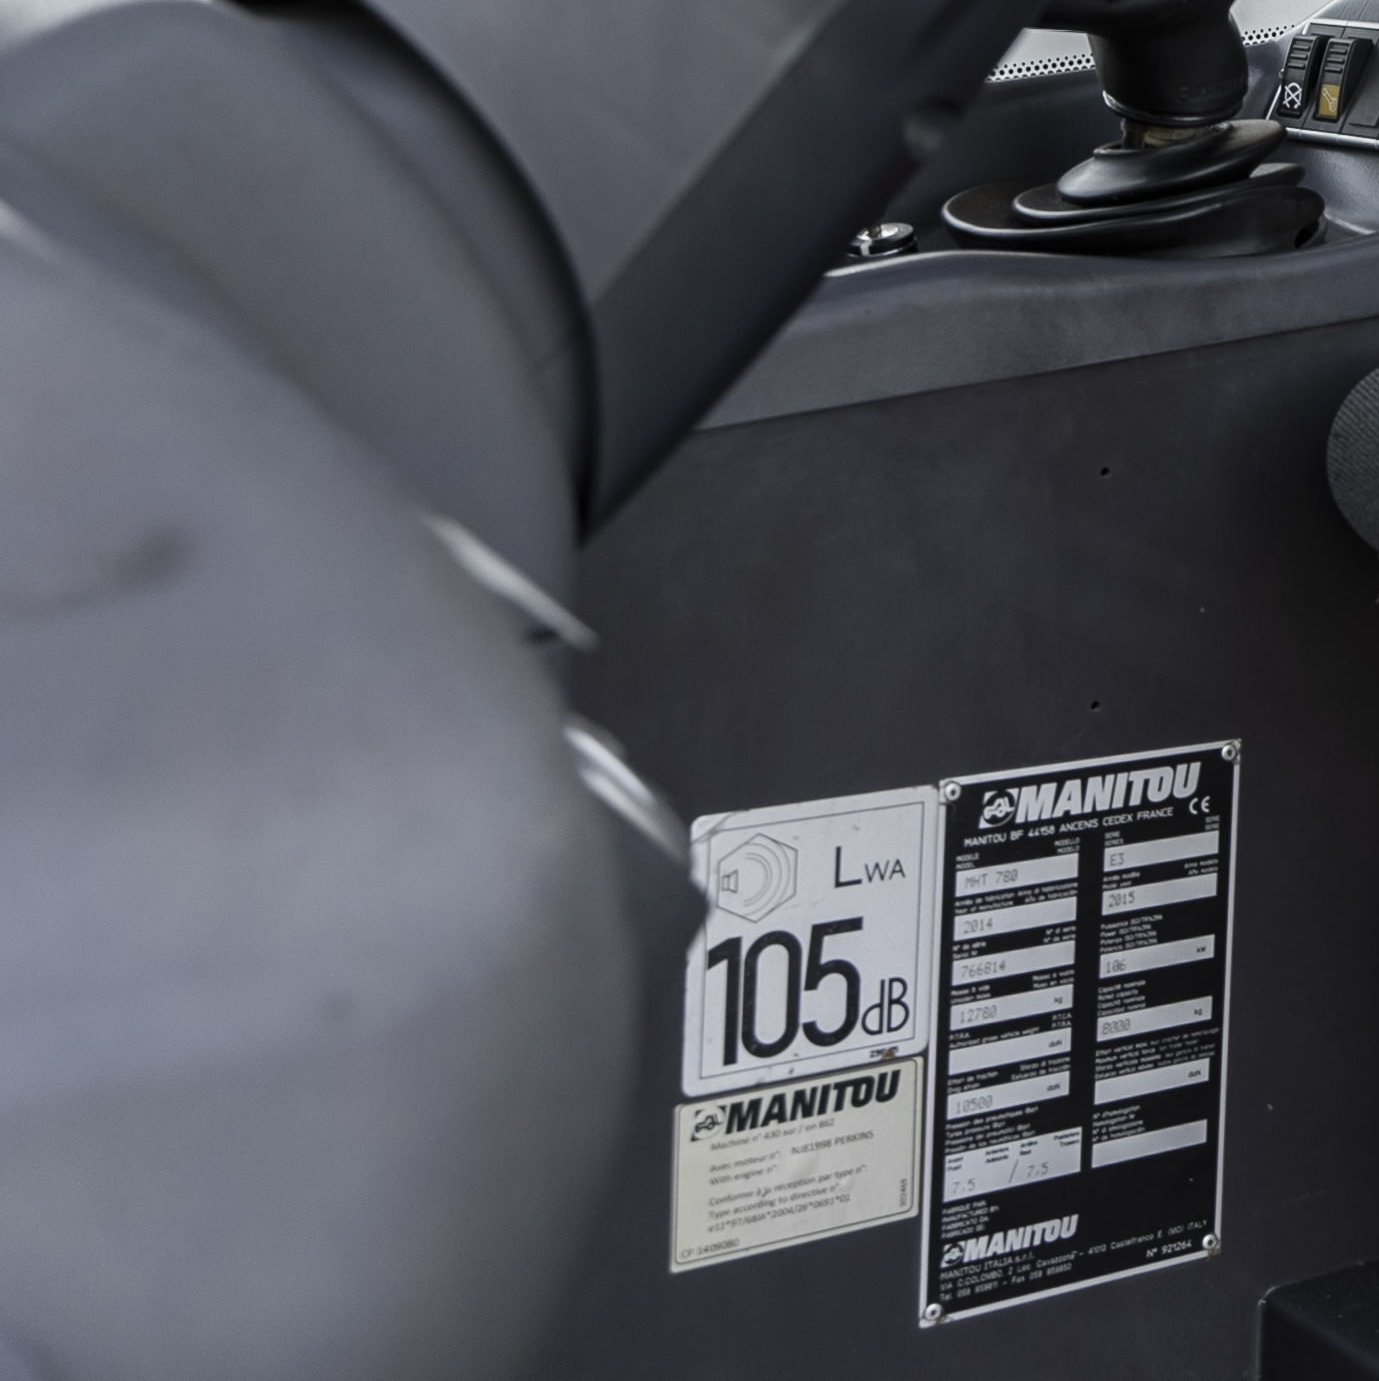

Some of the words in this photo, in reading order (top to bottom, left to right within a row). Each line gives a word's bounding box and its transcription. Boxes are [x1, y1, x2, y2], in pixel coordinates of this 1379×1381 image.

[1015, 761, 1201, 824] MANITOU
[964, 832, 1008, 847] MANITOU
[1027, 824, 1055, 837] 44158
[1059, 817, 1098, 832] ANCENIS
[1102, 813, 1133, 826] CEDEX
[1137, 806, 1173, 821] FRANCE
[965, 873, 988, 888] MHT
[996, 868, 1018, 884] 780
[1108, 890, 1135, 908] 2015
[963, 918, 993, 934] 2014
[706, 916, 864, 1066] 105
[861, 976, 910, 1036] dB
[725, 1069, 902, 1135] MANITOU
[710, 1160, 732, 1173] Avec
[734, 1152, 768, 1168] moteur
[835, 1129, 875, 1146] PERKINS
[710, 1175, 732, 1186] With
[734, 1167, 764, 1183] engine
[709, 1191, 755, 1207] Conforme
[733, 1197, 776, 1214] according
[790, 1187, 830, 1202] directive
[1187, 1219, 1208, 1231] ITALY
[963, 1214, 1080, 1264] MANITOU
[1161, 1239, 1193, 1255] 921264
[940, 1263, 981, 1280] MANITOU
[984, 1255, 1013, 1271] ITALIA
